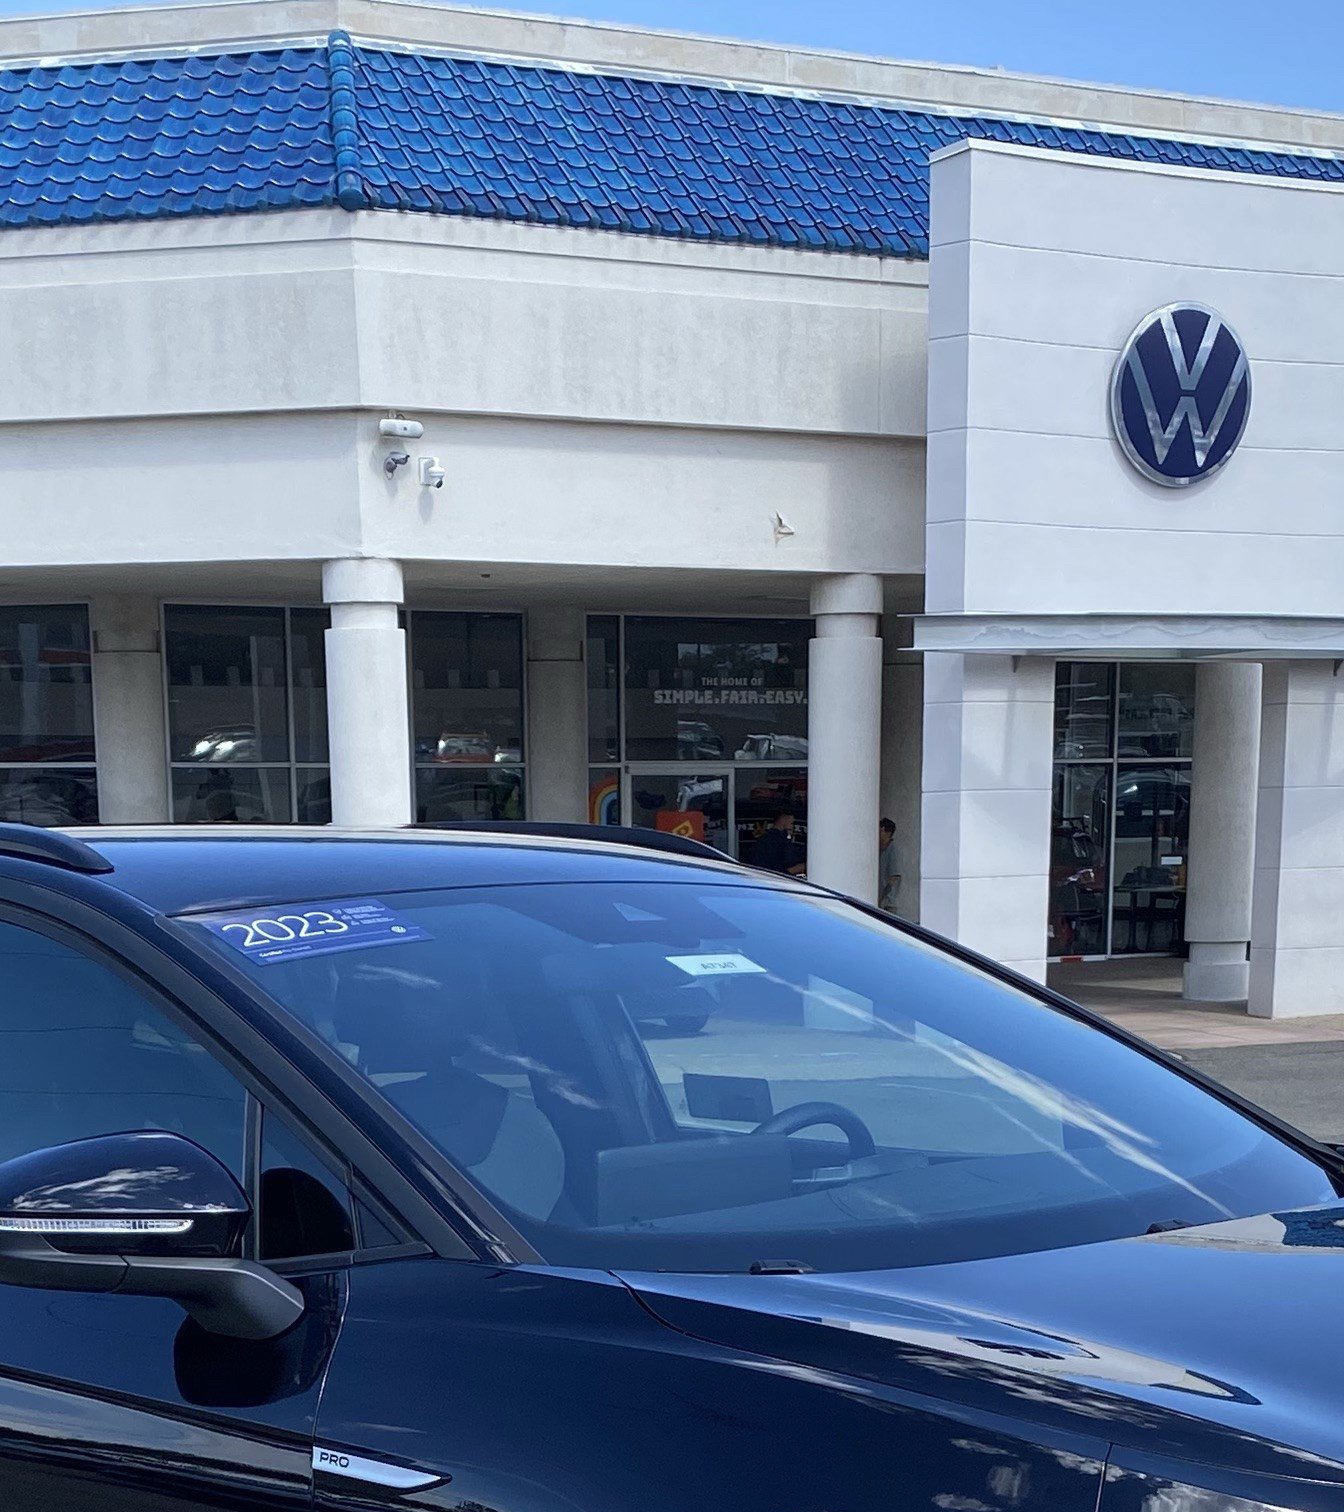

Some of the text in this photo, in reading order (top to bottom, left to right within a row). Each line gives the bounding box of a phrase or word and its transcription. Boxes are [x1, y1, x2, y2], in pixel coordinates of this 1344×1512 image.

[701, 677, 763, 686] THE HOME OF
[221, 911, 349, 947] 2023
[319, 1451, 350, 1469] PRO
